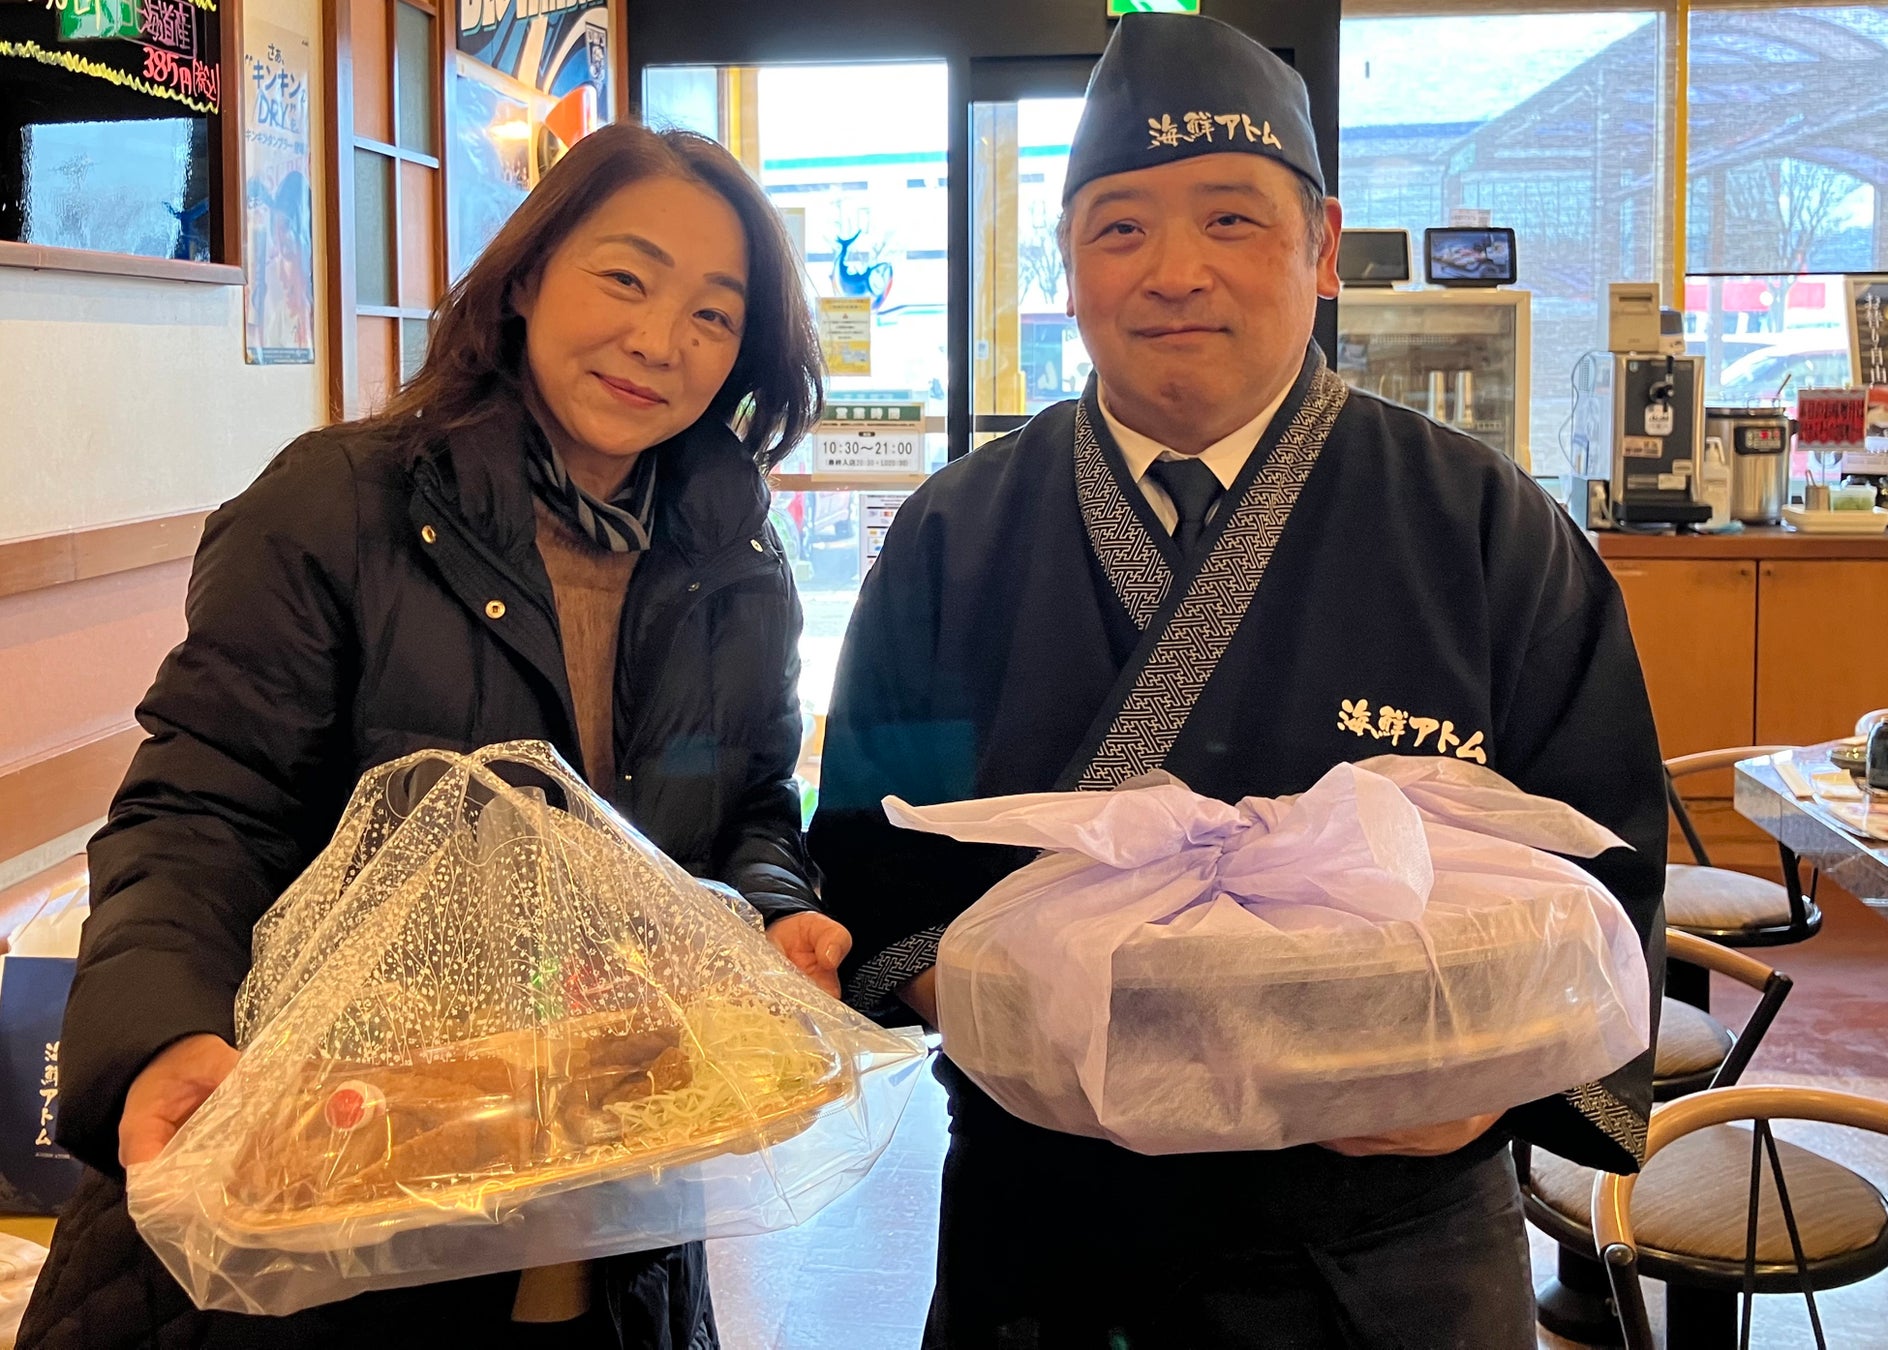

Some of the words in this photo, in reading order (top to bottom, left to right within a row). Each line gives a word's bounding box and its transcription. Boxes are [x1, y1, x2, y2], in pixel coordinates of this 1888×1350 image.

[1147, 111, 1282, 150] 海鮮アトム
[1336, 698, 1487, 764] 海鮮アトム
